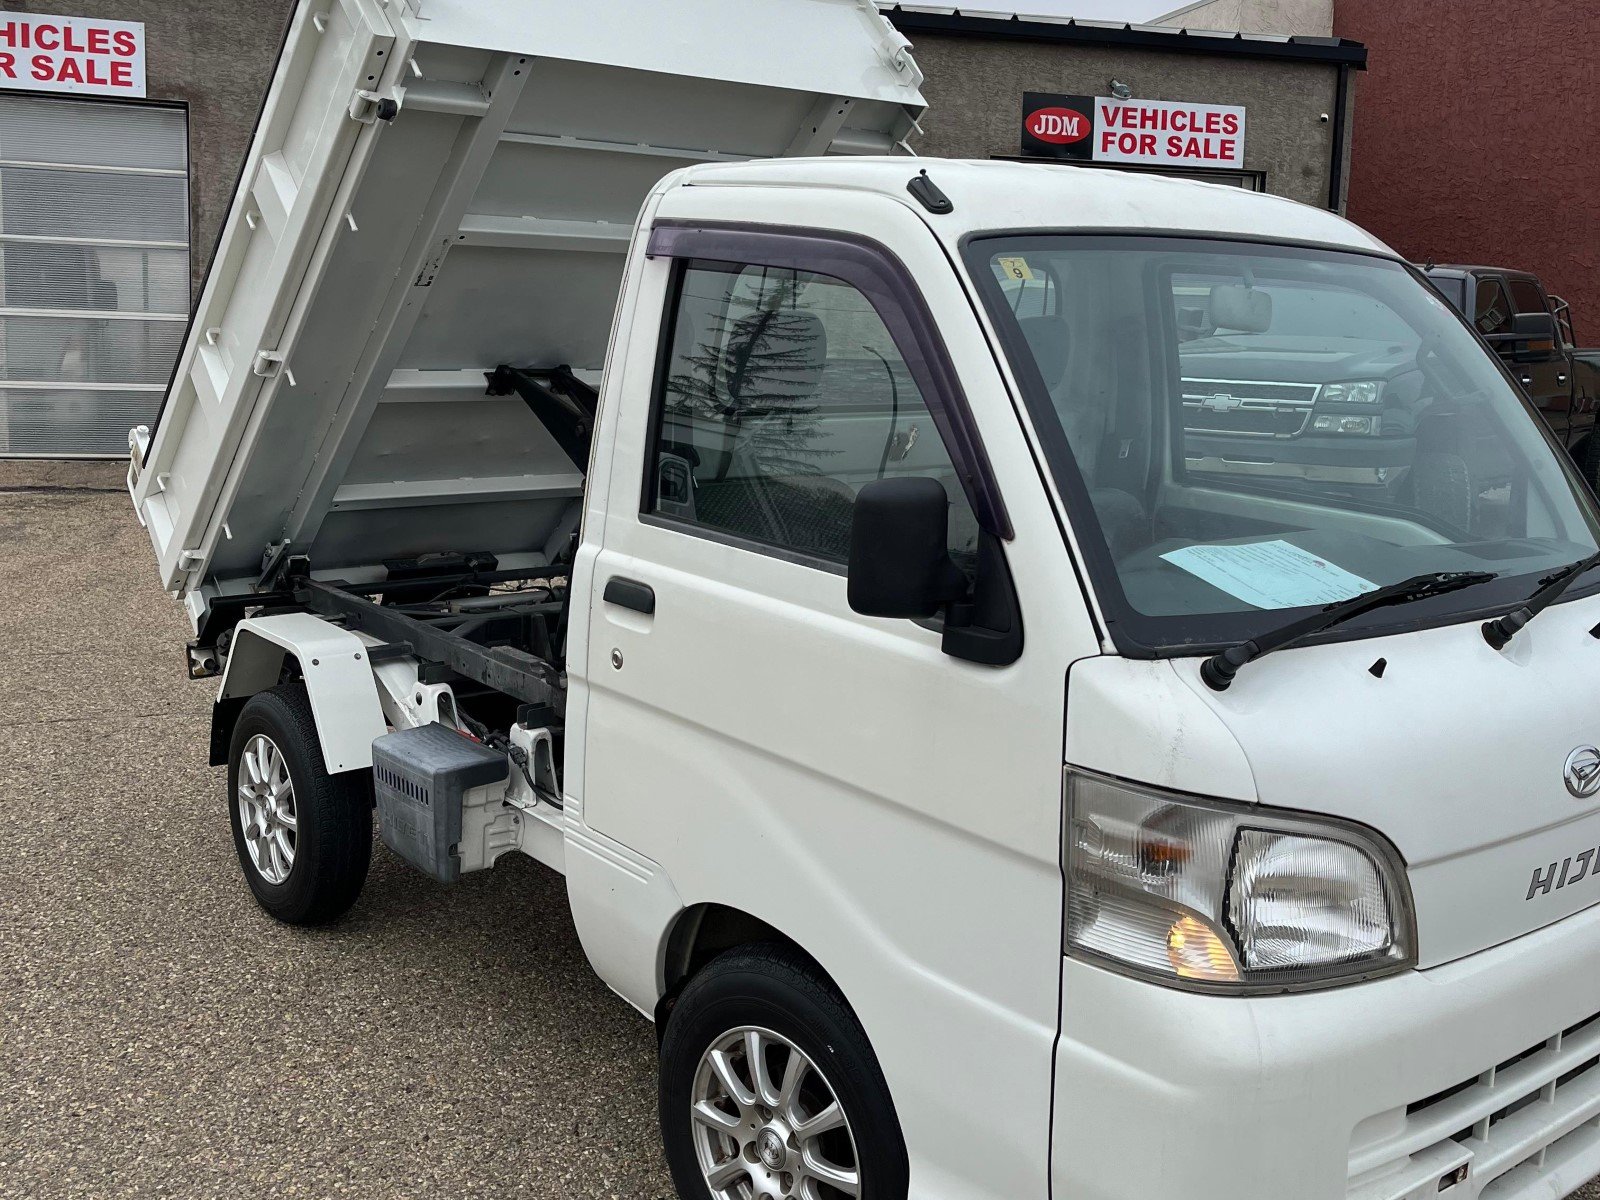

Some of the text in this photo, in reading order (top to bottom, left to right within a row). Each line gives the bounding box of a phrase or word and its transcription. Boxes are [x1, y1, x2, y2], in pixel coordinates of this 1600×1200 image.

[31, 54, 133, 87] SALE
[1034, 114, 1080, 137] JDM
[1101, 105, 1238, 135] VEHICLES
[1102, 132, 1235, 160] FOR SALE
[1013, 268, 1024, 279] 9
